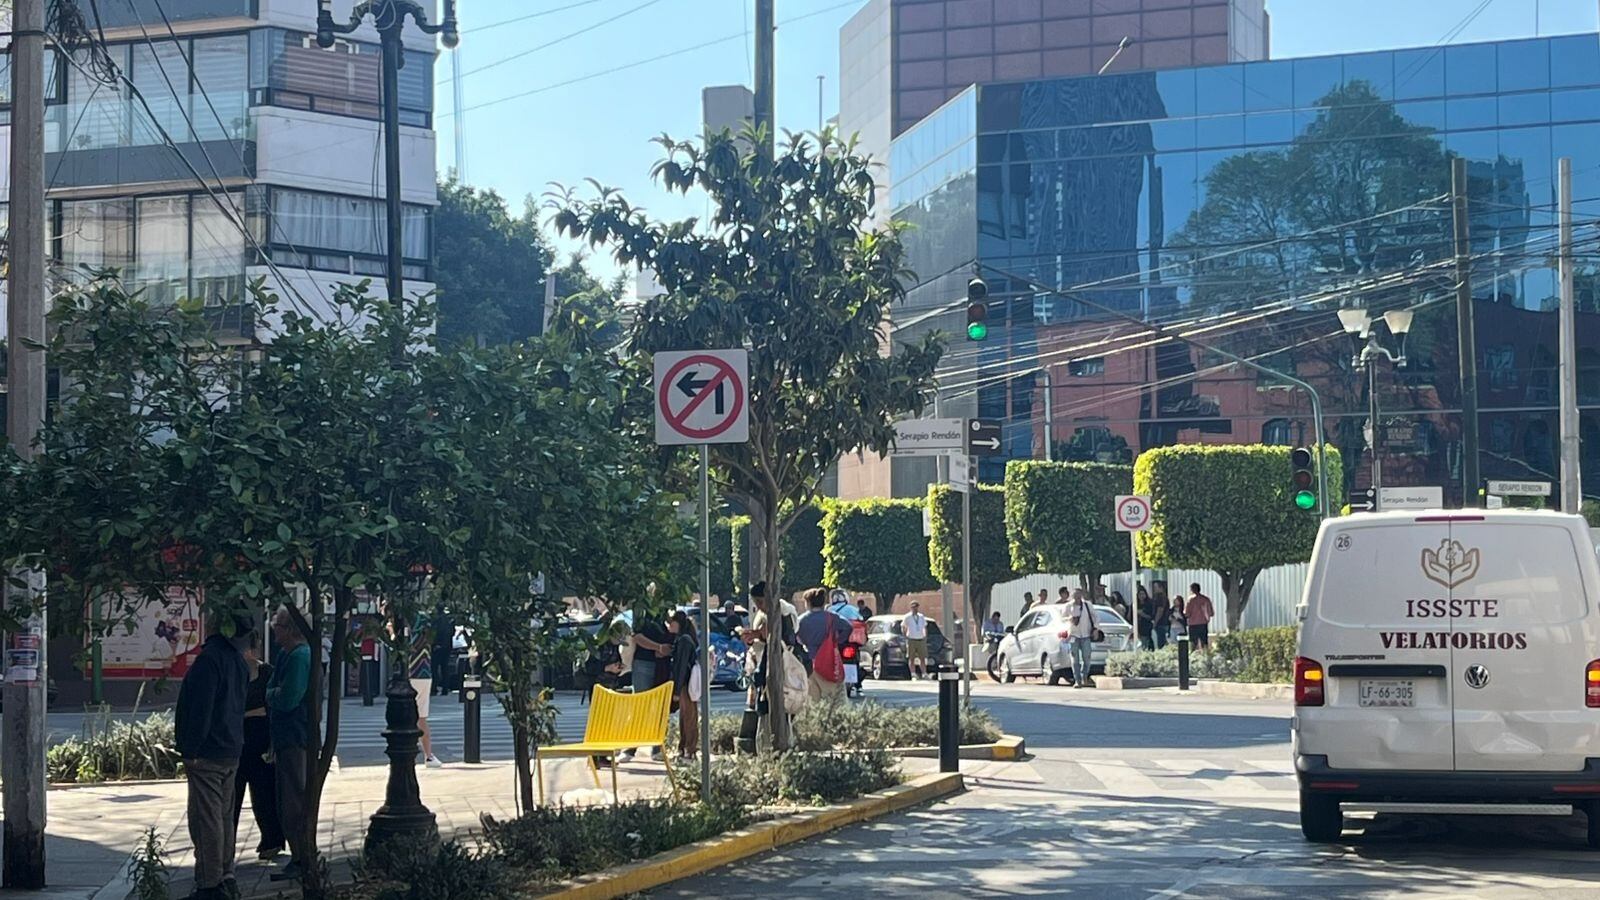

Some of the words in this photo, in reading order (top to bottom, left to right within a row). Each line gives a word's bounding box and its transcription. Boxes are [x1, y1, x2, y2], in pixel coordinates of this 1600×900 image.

[900, 432, 929, 441] Serapio
[931, 430, 961, 440] Rendón
[1127, 505, 1140, 515] 30
[1338, 536, 1350, 548] 26
[1406, 599, 1498, 618] ISSSTE
[1380, 632, 1527, 650] VELATORIOS
[1361, 687, 1413, 698] LF-66-305
